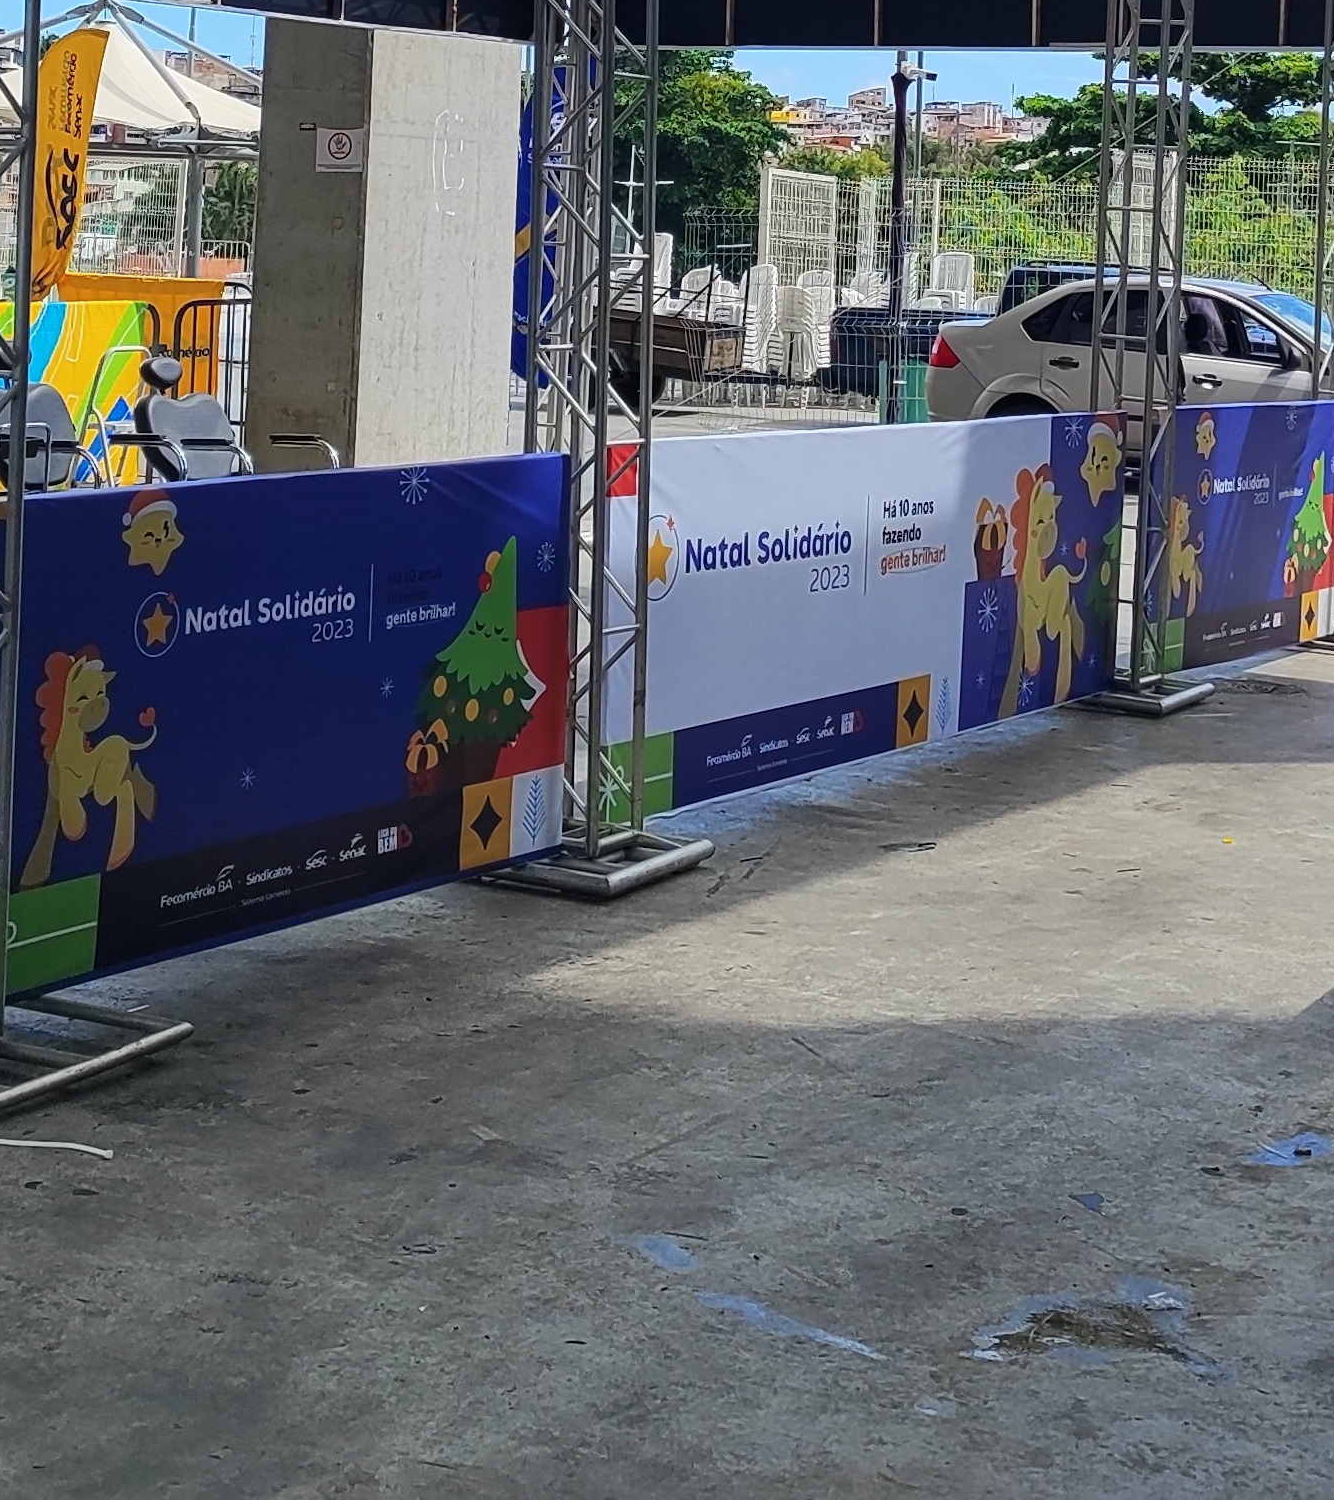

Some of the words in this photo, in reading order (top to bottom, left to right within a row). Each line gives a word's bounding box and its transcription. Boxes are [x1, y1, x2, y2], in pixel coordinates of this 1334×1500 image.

[883, 500, 897, 519] Há
[899, 498, 909, 517] 10
[911, 498, 934, 516] anos
[685, 532, 751, 574] Natal
[757, 521, 852, 564] Solidário
[882, 523, 921, 546] fazendo
[880, 550, 910, 575] gente
[911, 545, 946, 569] brilhar!
[809, 565, 850, 593] 2023
[184, 600, 251, 635] Natal
[257, 585, 356, 625] Solidário
[386, 610, 417, 629] gente
[419, 602, 455, 621] brilhar!
[311, 619, 354, 642] 2023
[378, 836, 398, 855] BEM
[160, 885, 215, 908] Fecomércio
[218, 879, 233, 893] BA
[246, 866, 293, 886] Sindicatos
[305, 855, 327, 870] Sesc
[339, 845, 366, 862] Senac
